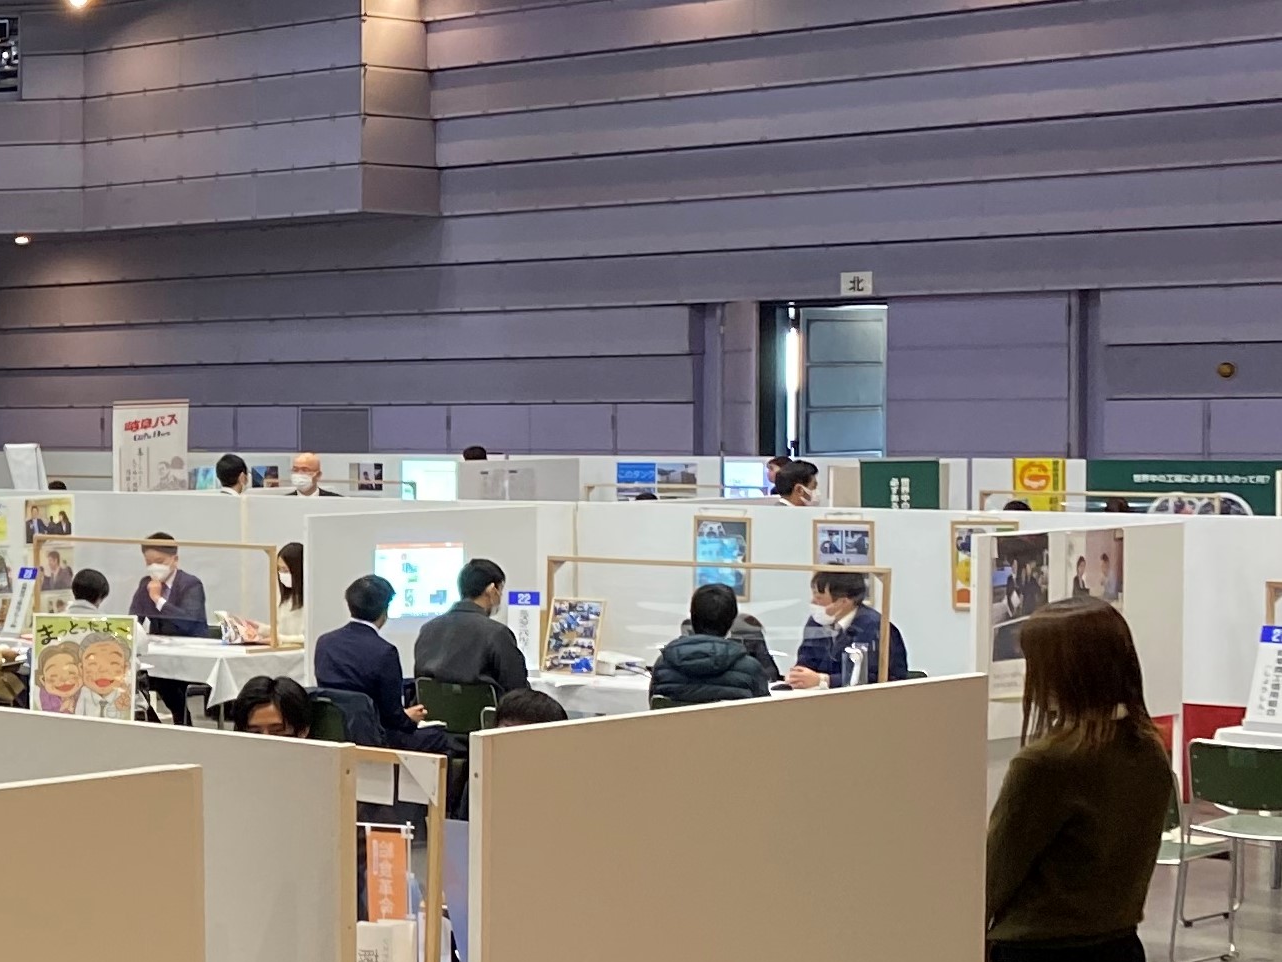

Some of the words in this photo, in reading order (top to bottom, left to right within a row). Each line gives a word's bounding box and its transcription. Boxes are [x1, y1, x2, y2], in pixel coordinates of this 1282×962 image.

[848, 275, 864, 292] 北
[124, 413, 178, 432] 岐阜バス
[517, 593, 532, 605] 22
